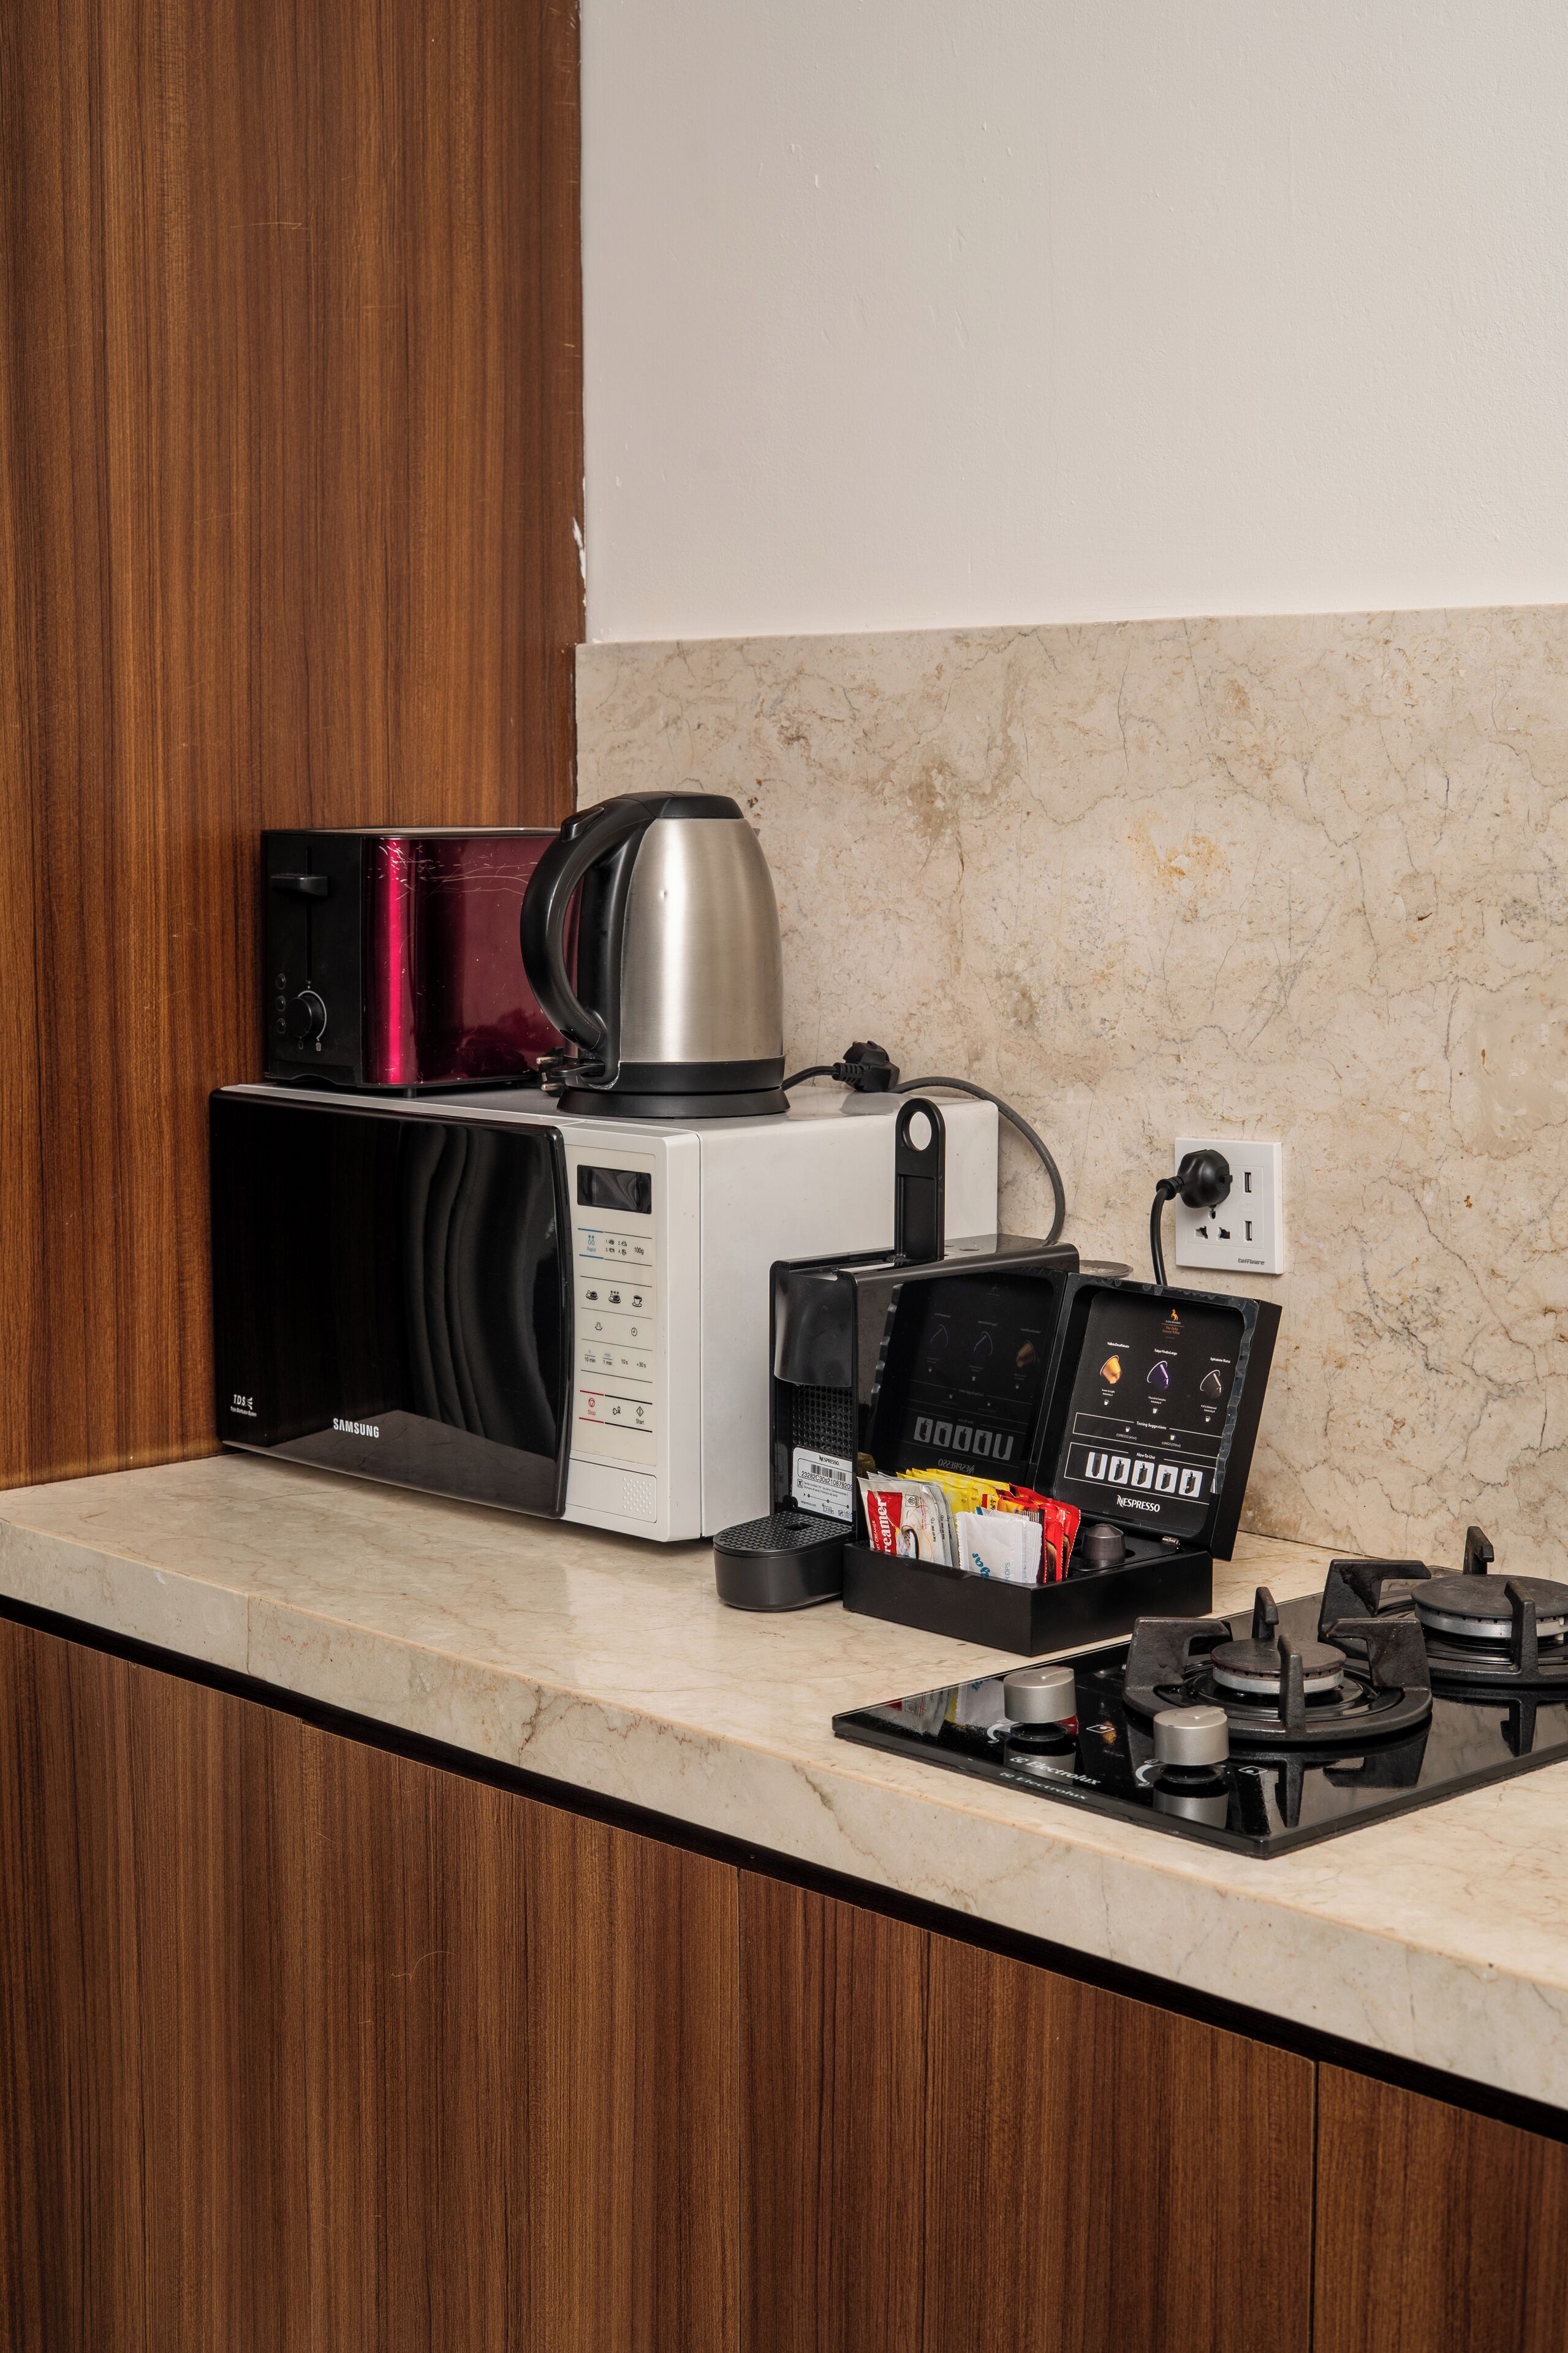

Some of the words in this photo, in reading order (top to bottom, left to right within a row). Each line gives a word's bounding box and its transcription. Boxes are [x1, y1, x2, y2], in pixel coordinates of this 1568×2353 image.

[333, 1417, 379, 1438] SAMSUNG
[1116, 1495, 1160, 1512] NESPRESSO
[877, 1498, 892, 1553] reamer
[972, 1553, 990, 1578] gar
[1025, 1761, 1102, 1785] Electrolux
[1016, 1777, 1088, 1800] Electrolux
